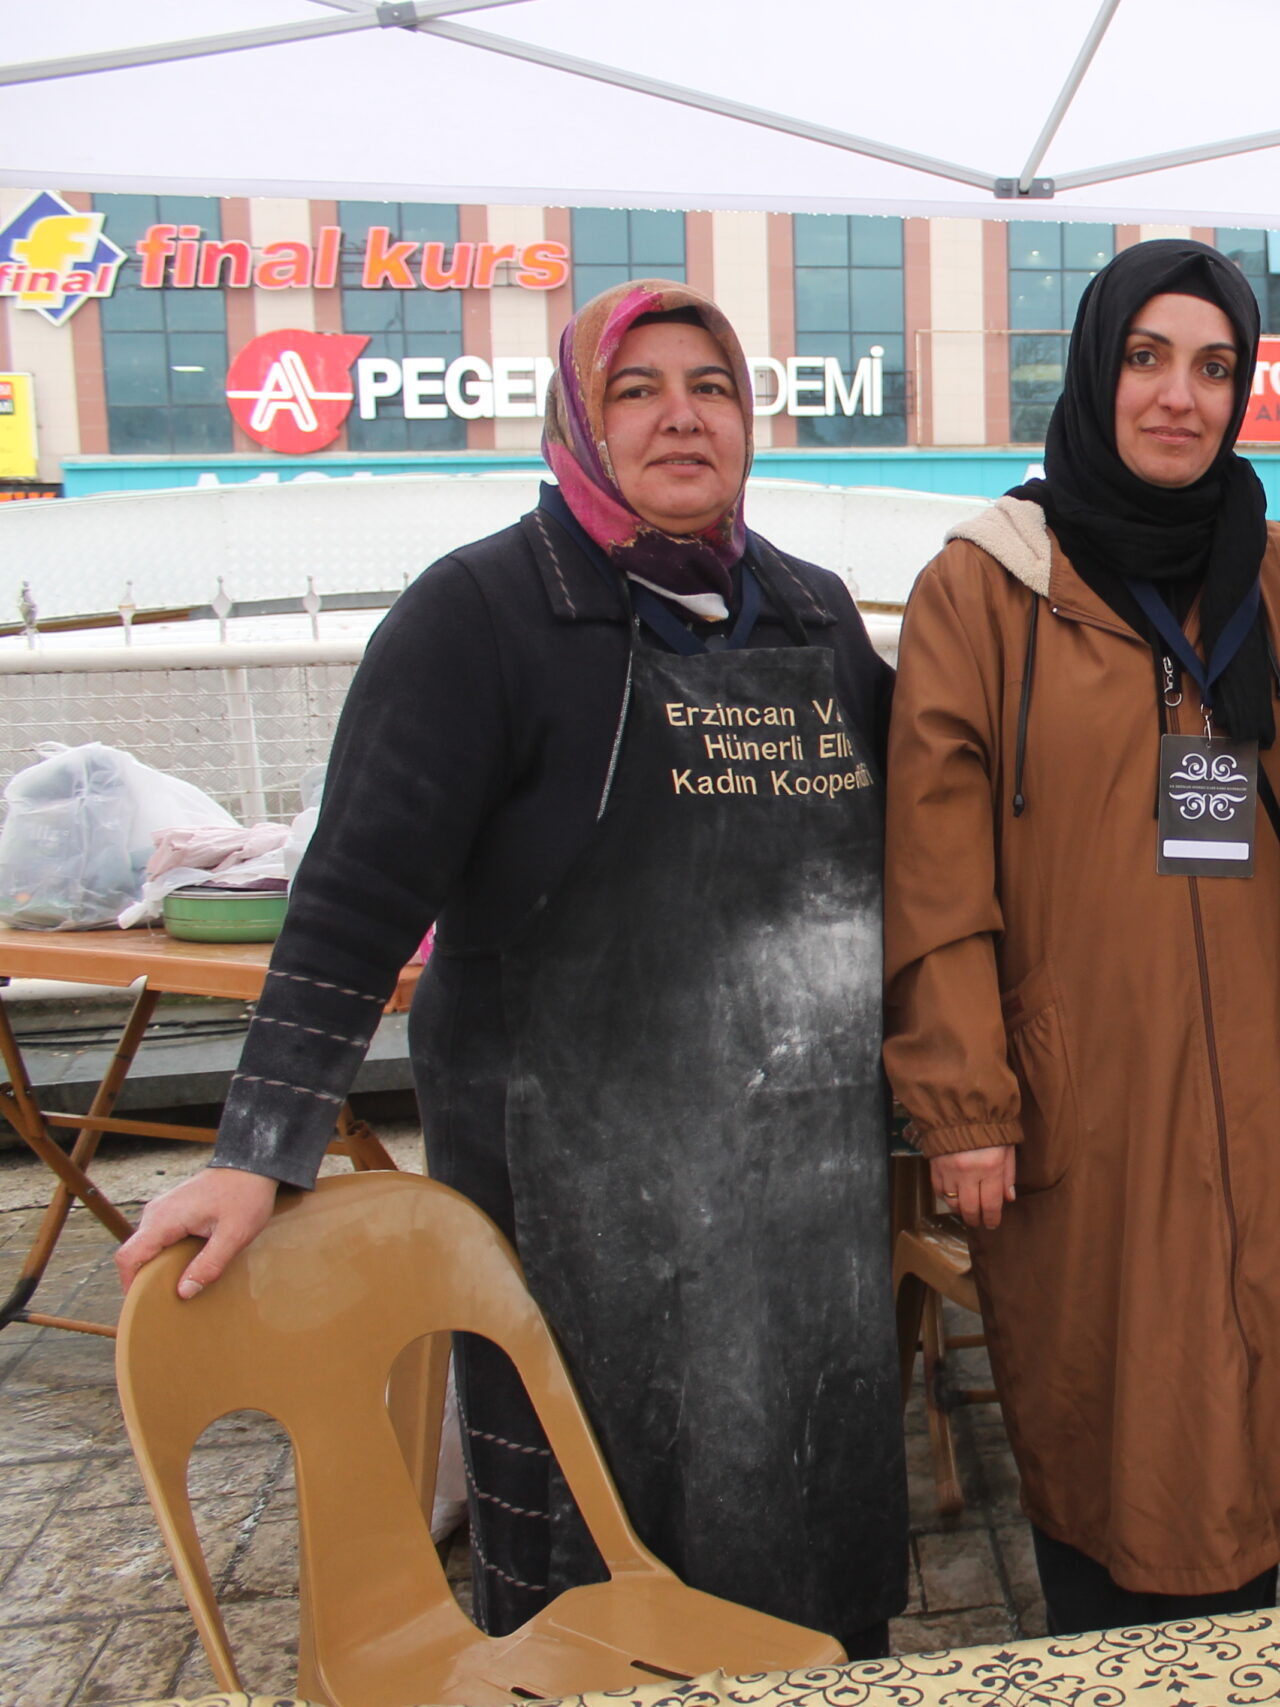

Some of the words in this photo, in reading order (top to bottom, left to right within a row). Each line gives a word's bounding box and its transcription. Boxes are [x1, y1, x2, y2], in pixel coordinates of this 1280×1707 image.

[136, 223, 341, 290] final
[361, 225, 570, 291] kurs
[746, 345, 885, 416] DEMİ
[665, 702, 796, 727] Erzincan
[703, 734, 804, 761] Hünerli
[672, 767, 758, 796] Kadın
